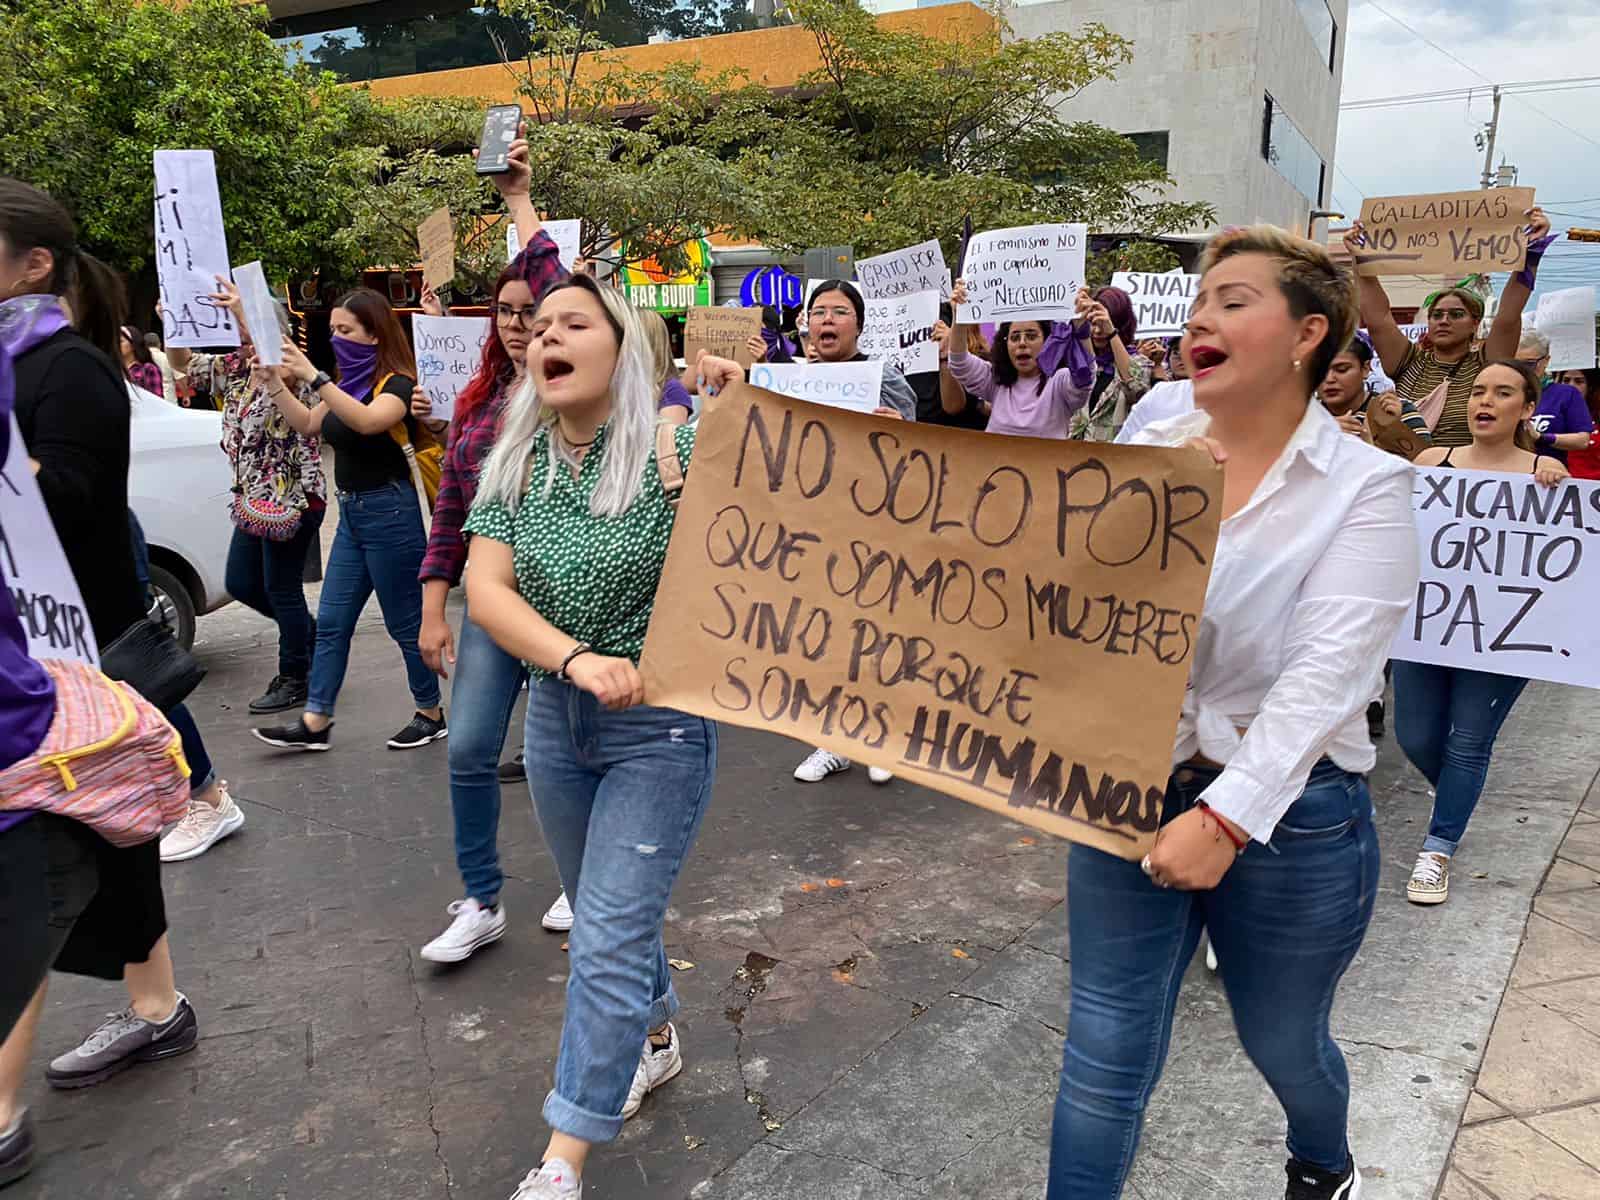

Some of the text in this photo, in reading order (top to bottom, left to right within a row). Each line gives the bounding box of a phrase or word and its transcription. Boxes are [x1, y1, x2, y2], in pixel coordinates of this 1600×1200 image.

[1370, 195, 1508, 225] CALLADITAS
[1057, 234, 1076, 248] NO
[1361, 228, 1397, 251] NO
[1448, 226, 1523, 265] VEMOS
[910, 250, 937, 273] POR
[967, 262, 977, 274] es
[983, 260, 996, 271] un
[630, 285, 657, 308] BAR
[967, 280, 978, 292] es
[1127, 273, 1200, 298] SINAL
[449, 359, 468, 375] de
[754, 367, 871, 397] Queremos
[734, 403, 1210, 569] NO SOLO POR
[1430, 522, 1582, 582] GRITO
[705, 504, 1197, 664] QUE SOMOS MUJERES
[1414, 581, 1571, 657] PAZ.
[700, 582, 1039, 726] SINO PORQUE
[711, 656, 1164, 833] SOMOS HUMANOS
